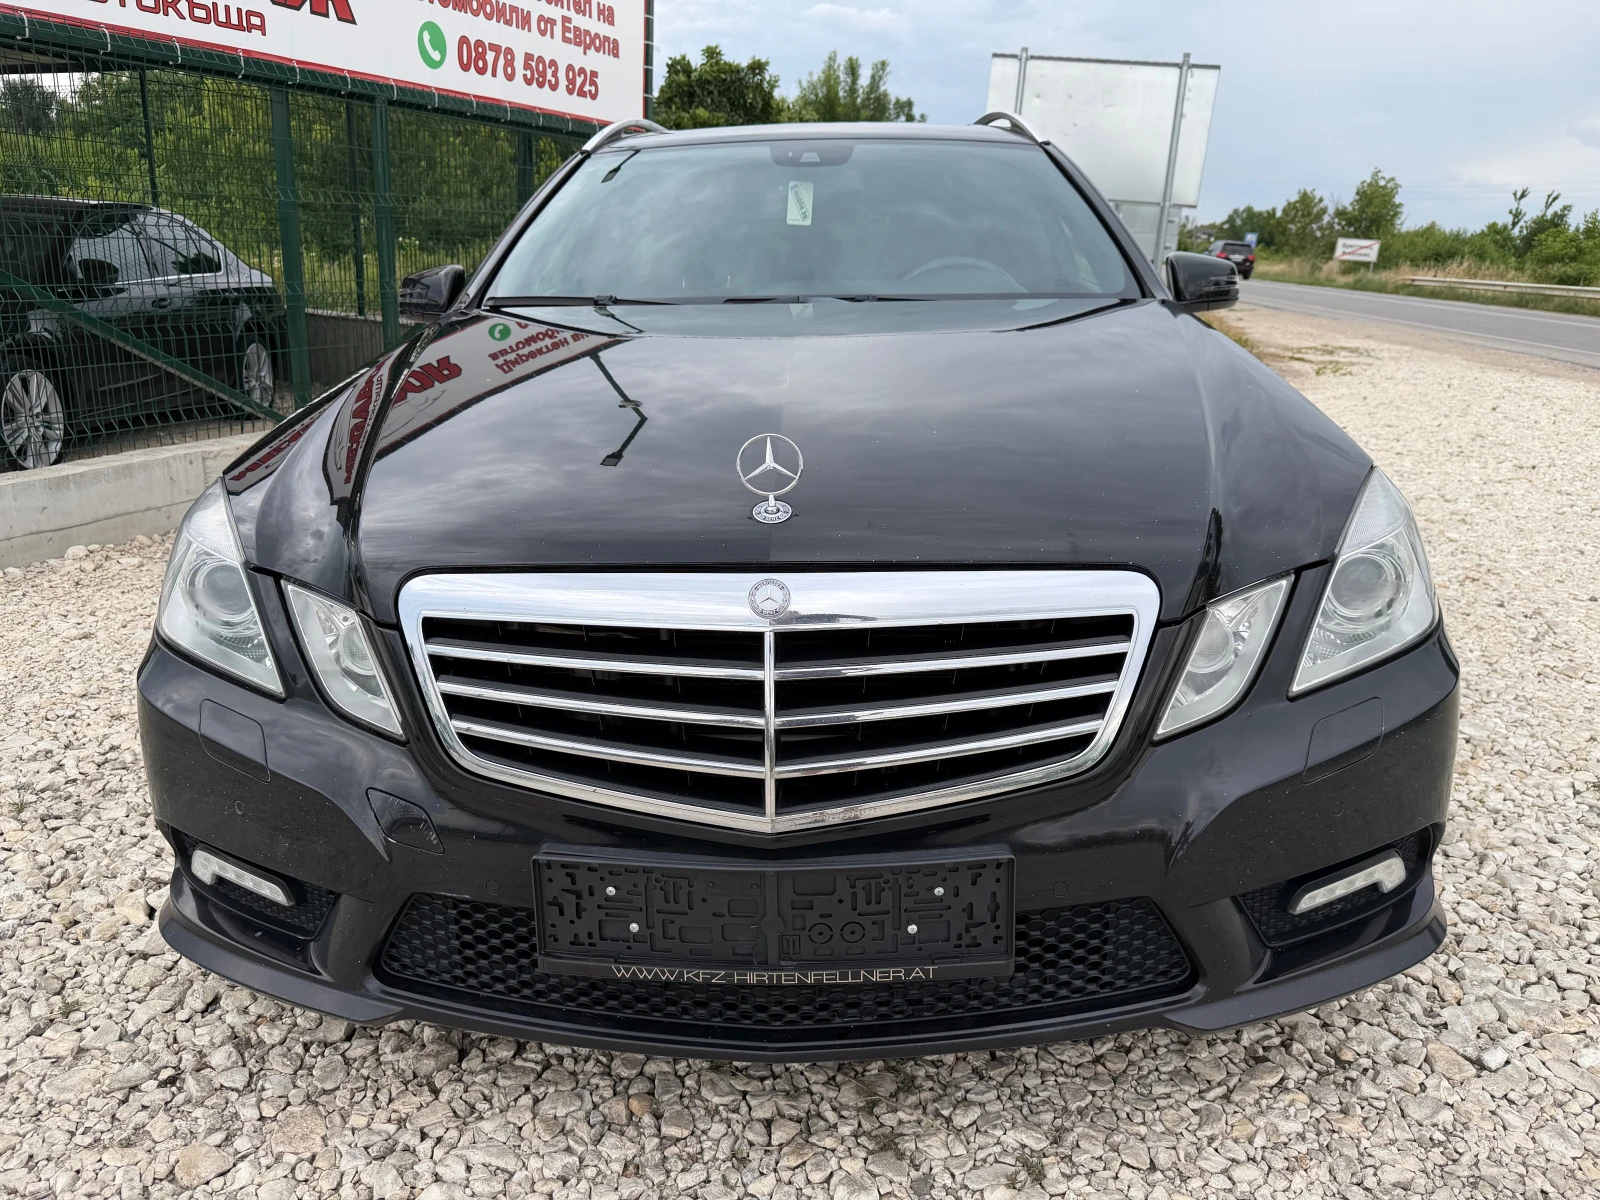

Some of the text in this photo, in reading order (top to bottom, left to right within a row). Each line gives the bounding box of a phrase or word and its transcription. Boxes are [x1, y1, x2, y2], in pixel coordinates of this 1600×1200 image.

[597, 2, 615, 27] на
[537, 14, 557, 39] от
[561, 15, 620, 58] Европа
[457, 35, 599, 101] 0878 593 925
[611, 965, 939, 984] WWW.KFZ-HIRTENFELLNER.AT
